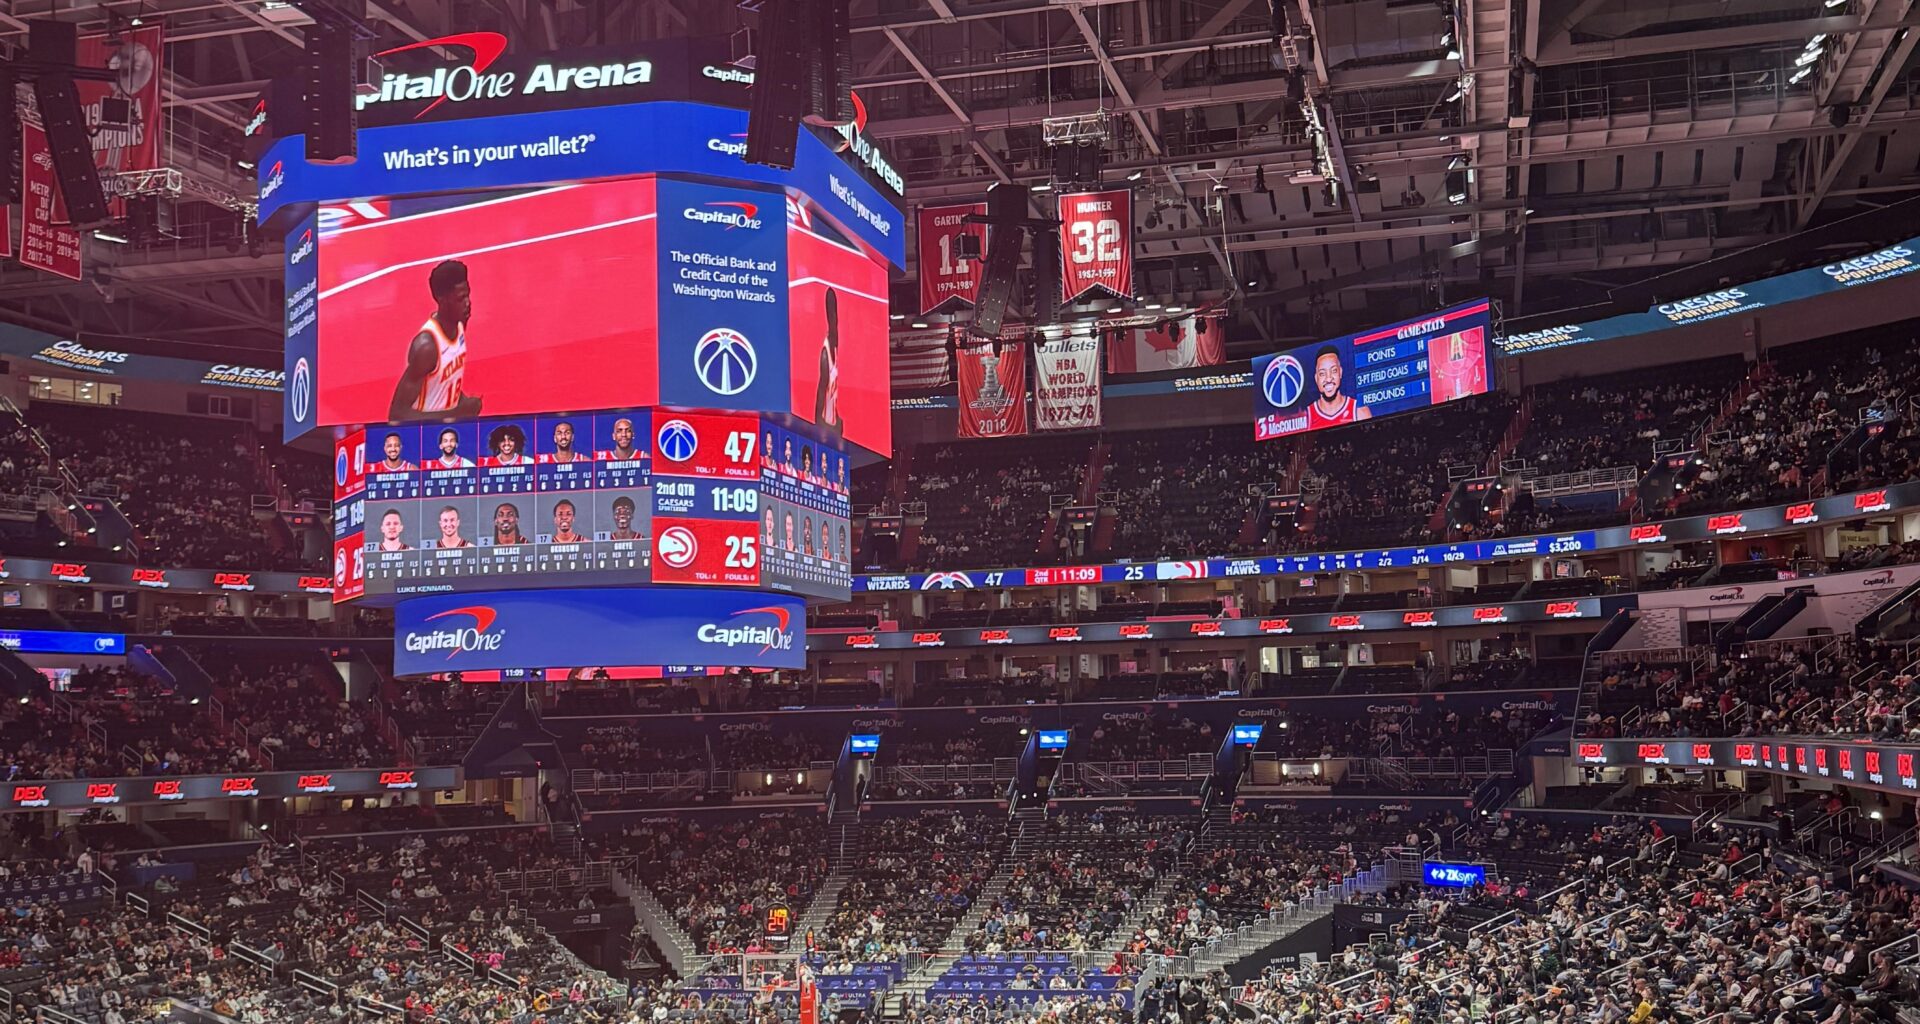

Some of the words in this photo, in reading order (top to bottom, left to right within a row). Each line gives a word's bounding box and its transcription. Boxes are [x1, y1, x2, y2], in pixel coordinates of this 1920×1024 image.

[523, 61, 652, 94] Arena
[453, 145, 469, 163] in
[474, 141, 517, 166] your
[871, 147, 903, 196] Arena
[850, 191, 858, 212] in
[857, 201, 870, 222] your
[1077, 201, 1112, 213] HUNTER
[1071, 219, 1121, 264] 32
[671, 251, 690, 263] The
[693, 253, 728, 267] Official
[730, 257, 755, 270] Bank
[757, 261, 776, 272] and
[1823, 246, 1914, 275] CAESARS
[680, 268, 711, 282] Credit
[713, 271, 737, 285] Card
[739, 273, 751, 286] of
[751, 275, 768, 287] the
[1833, 258, 1912, 282] SPORTSBOOK
[673, 283, 734, 300] Washington
[736, 289, 775, 303] Wizards
[1658, 288, 1747, 315] CAESARS
[1667, 300, 1741, 321] SPORTSBOOK
[1398, 322, 1422, 340] GAME
[1421, 317, 1445, 335] STATS
[39, 347, 105, 367] SPORTSBOOK
[1367, 347, 1396, 363] POINTS
[1056, 358, 1077, 371] NBA
[1357, 374, 1371, 385] 3-PT
[1371, 370, 1387, 383] FIELD
[1388, 364, 1408, 379] GOALS
[1417, 359, 1428, 372] 4/4
[204, 371, 280, 387] SPORTSBOOK
[1049, 373, 1086, 385] WORLD
[1175, 376, 1244, 387] SPORTSBOOK
[1038, 385, 1098, 401] CHAMPIONS
[1363, 386, 1405, 404] REBOUNDS
[979, 418, 1007, 434] 2018
[1257, 417, 1267, 438] 3
[724, 431, 756, 463] 47
[599, 479, 605, 487] 4
[614, 478, 619, 486] 3
[628, 477, 634, 486] 5
[656, 482, 676, 495] 2nd
[677, 483, 695, 497] QTR
[658, 498, 694, 507] CAESARS
[711, 487, 758, 513] 11:09
[1855, 490, 1887, 508] DEX
[1786, 503, 1815, 519] DEX
[1708, 514, 1742, 530] DEX
[1630, 525, 1662, 540] DEX
[493, 547, 520, 555] WALLACE
[725, 535, 756, 568] 25
[1225, 565, 1261, 576] HAWKS
[1336, 561, 1346, 569] 14
[1378, 558, 1392, 567] 2/2
[1412, 555, 1430, 565] 3/14
[1443, 552, 1465, 561] 10/29
[1549, 541, 1582, 553] $3,200
[51, 563, 87, 577] DEX
[1060, 568, 1096, 581] 11:09
[1124, 566, 1144, 580] 25
[213, 572, 251, 586] DEX
[867, 581, 910, 591] WIZARDS
[985, 572, 1004, 586] 47
[396, 586, 416, 594] LUKE
[1546, 601, 1577, 615] DEX
[1404, 611, 1434, 623] DEX
[1191, 621, 1222, 633] DEX
[913, 632, 942, 642] DEX
[1638, 744, 1665, 758] DEX
[380, 771, 415, 784] DEX
[87, 783, 117, 797] DEX
[768, 917, 786, 931] 24
[1271, 956, 1295, 964] UNITED
